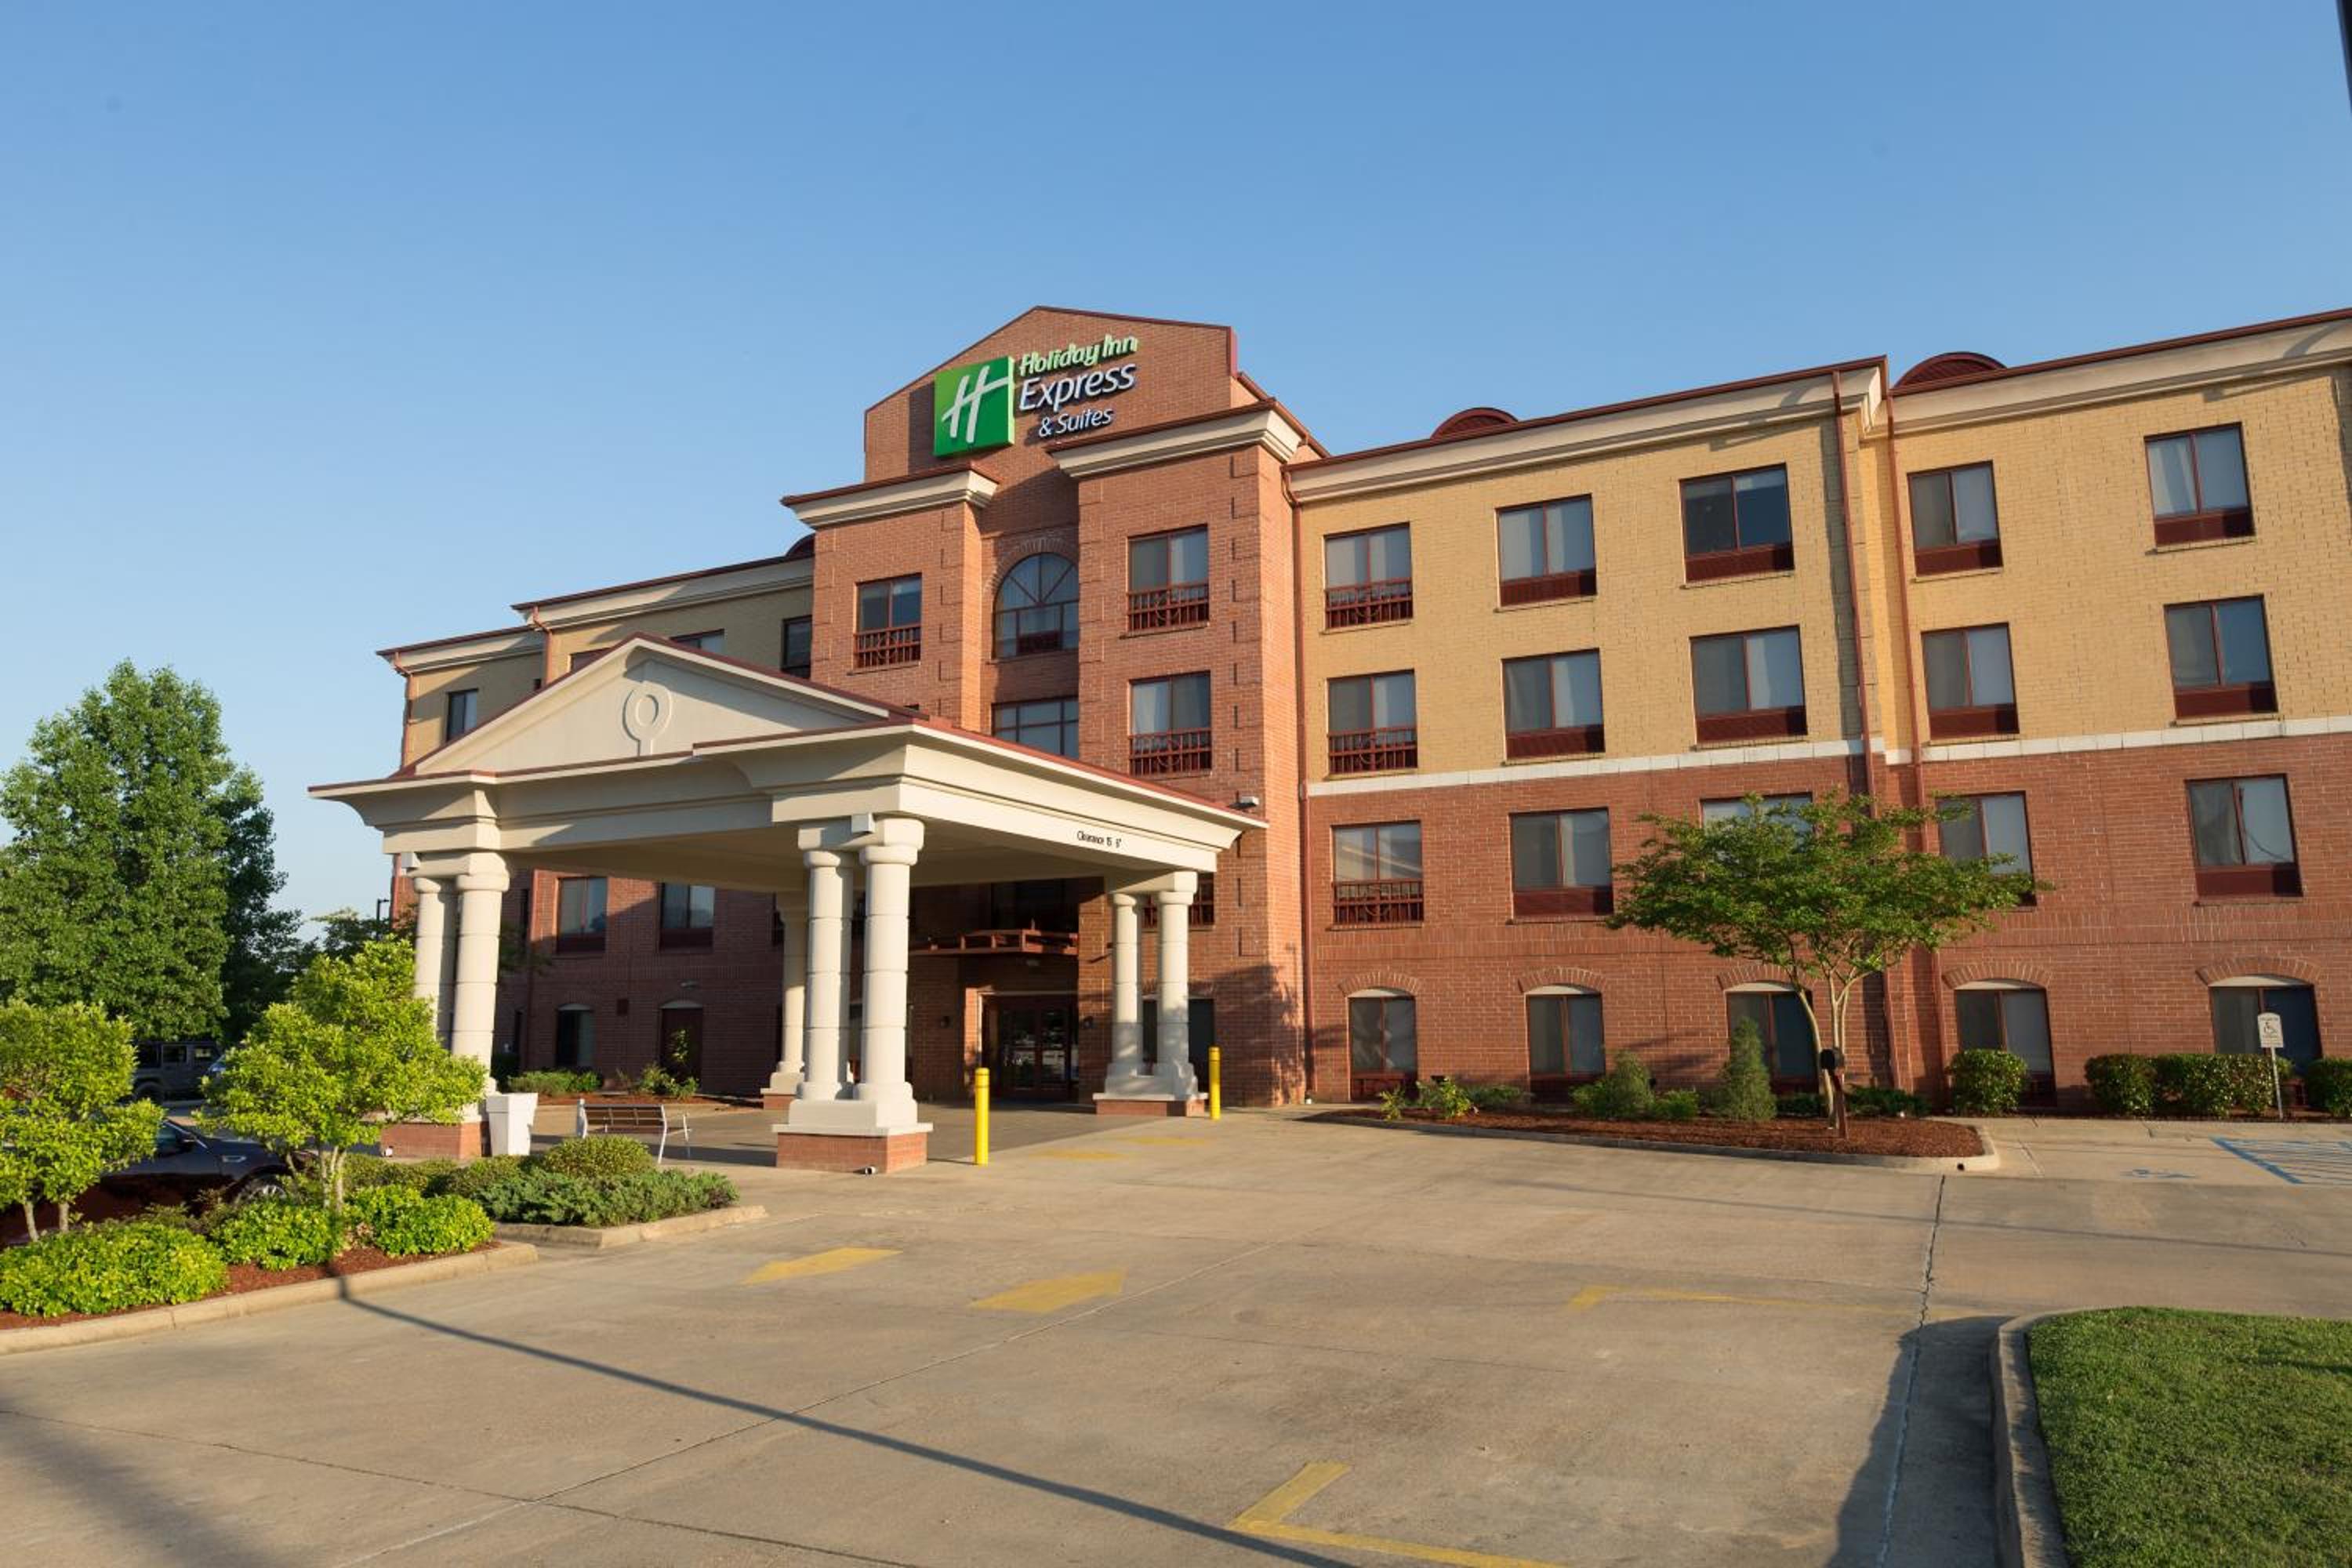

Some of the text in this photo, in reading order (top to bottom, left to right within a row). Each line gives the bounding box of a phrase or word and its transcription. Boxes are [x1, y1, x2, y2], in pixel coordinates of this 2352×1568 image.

[1020, 334, 1138, 376] Holiday Inn
[1019, 364, 1136, 412] Express
[1039, 408, 1113, 437] & Suites
